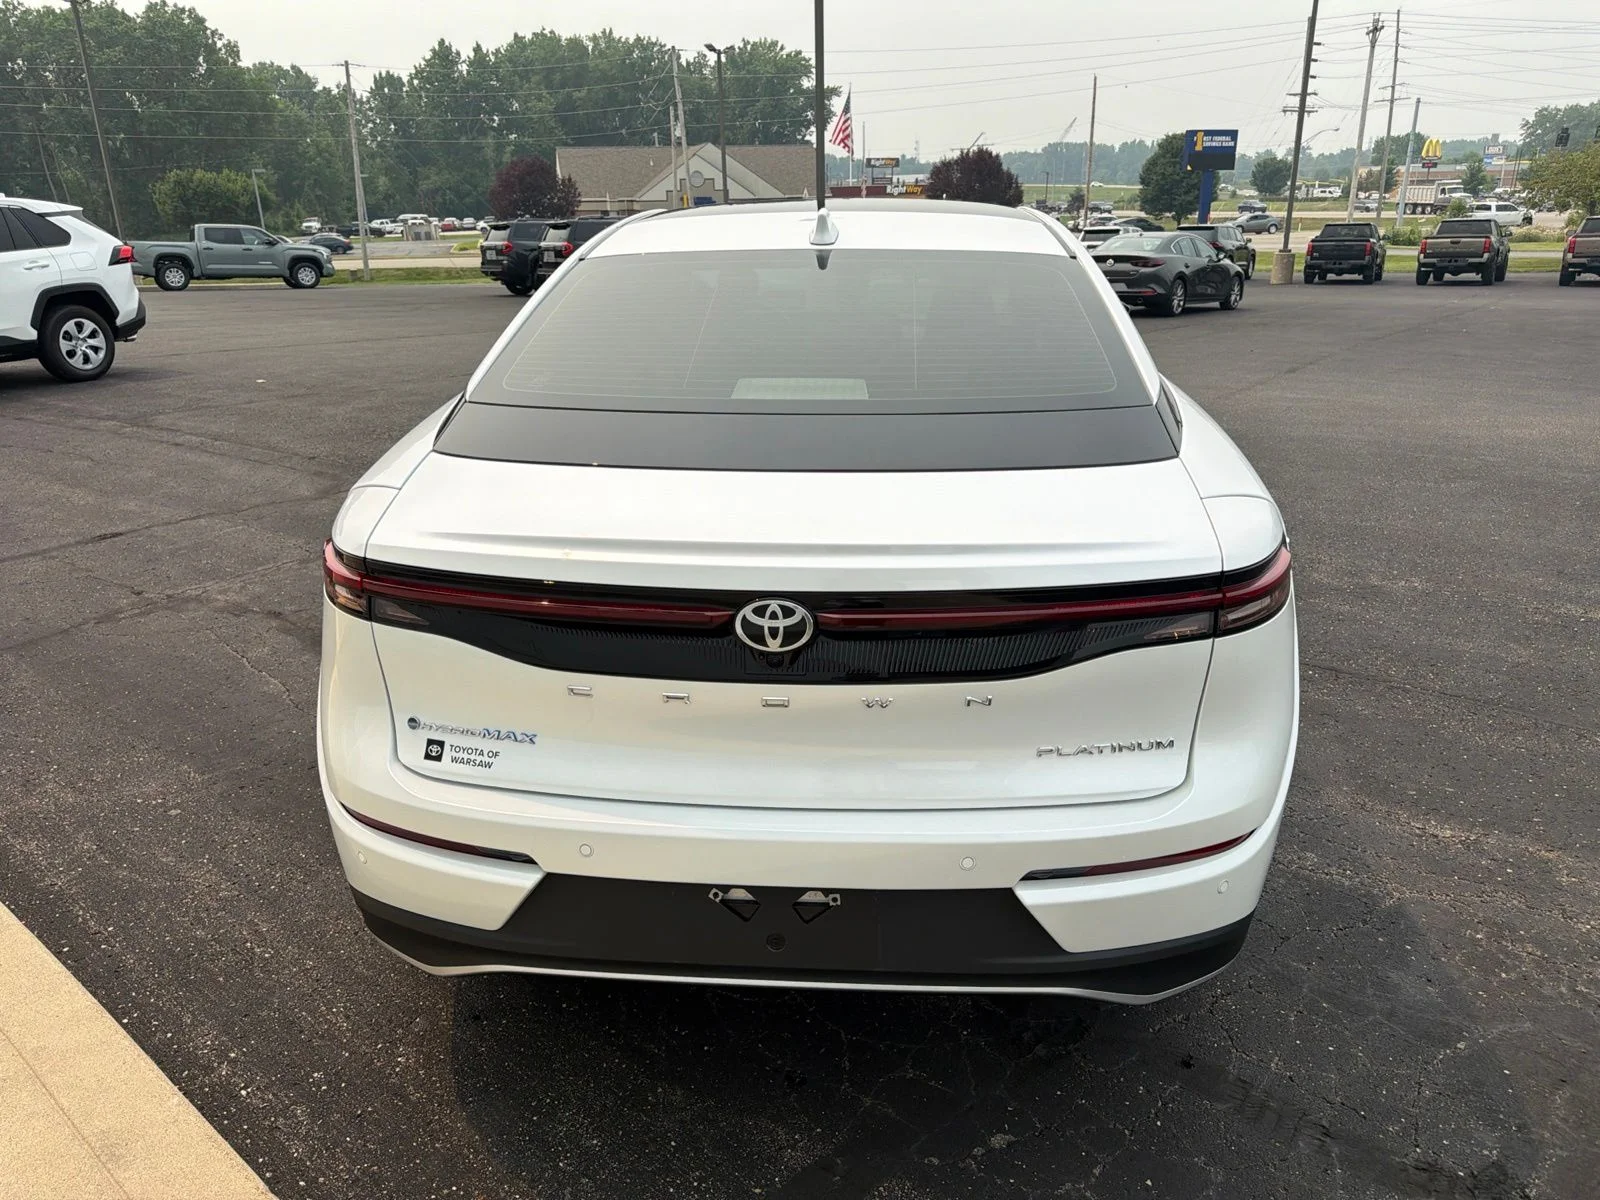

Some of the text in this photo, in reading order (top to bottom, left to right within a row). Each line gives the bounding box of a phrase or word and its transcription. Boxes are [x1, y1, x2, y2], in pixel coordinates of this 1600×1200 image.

[567, 685, 993, 708] CROWN
[449, 744, 500, 759] TOYOTA OF
[1036, 737, 1175, 757] PLATINUM
[450, 755, 494, 769] WARSAW
